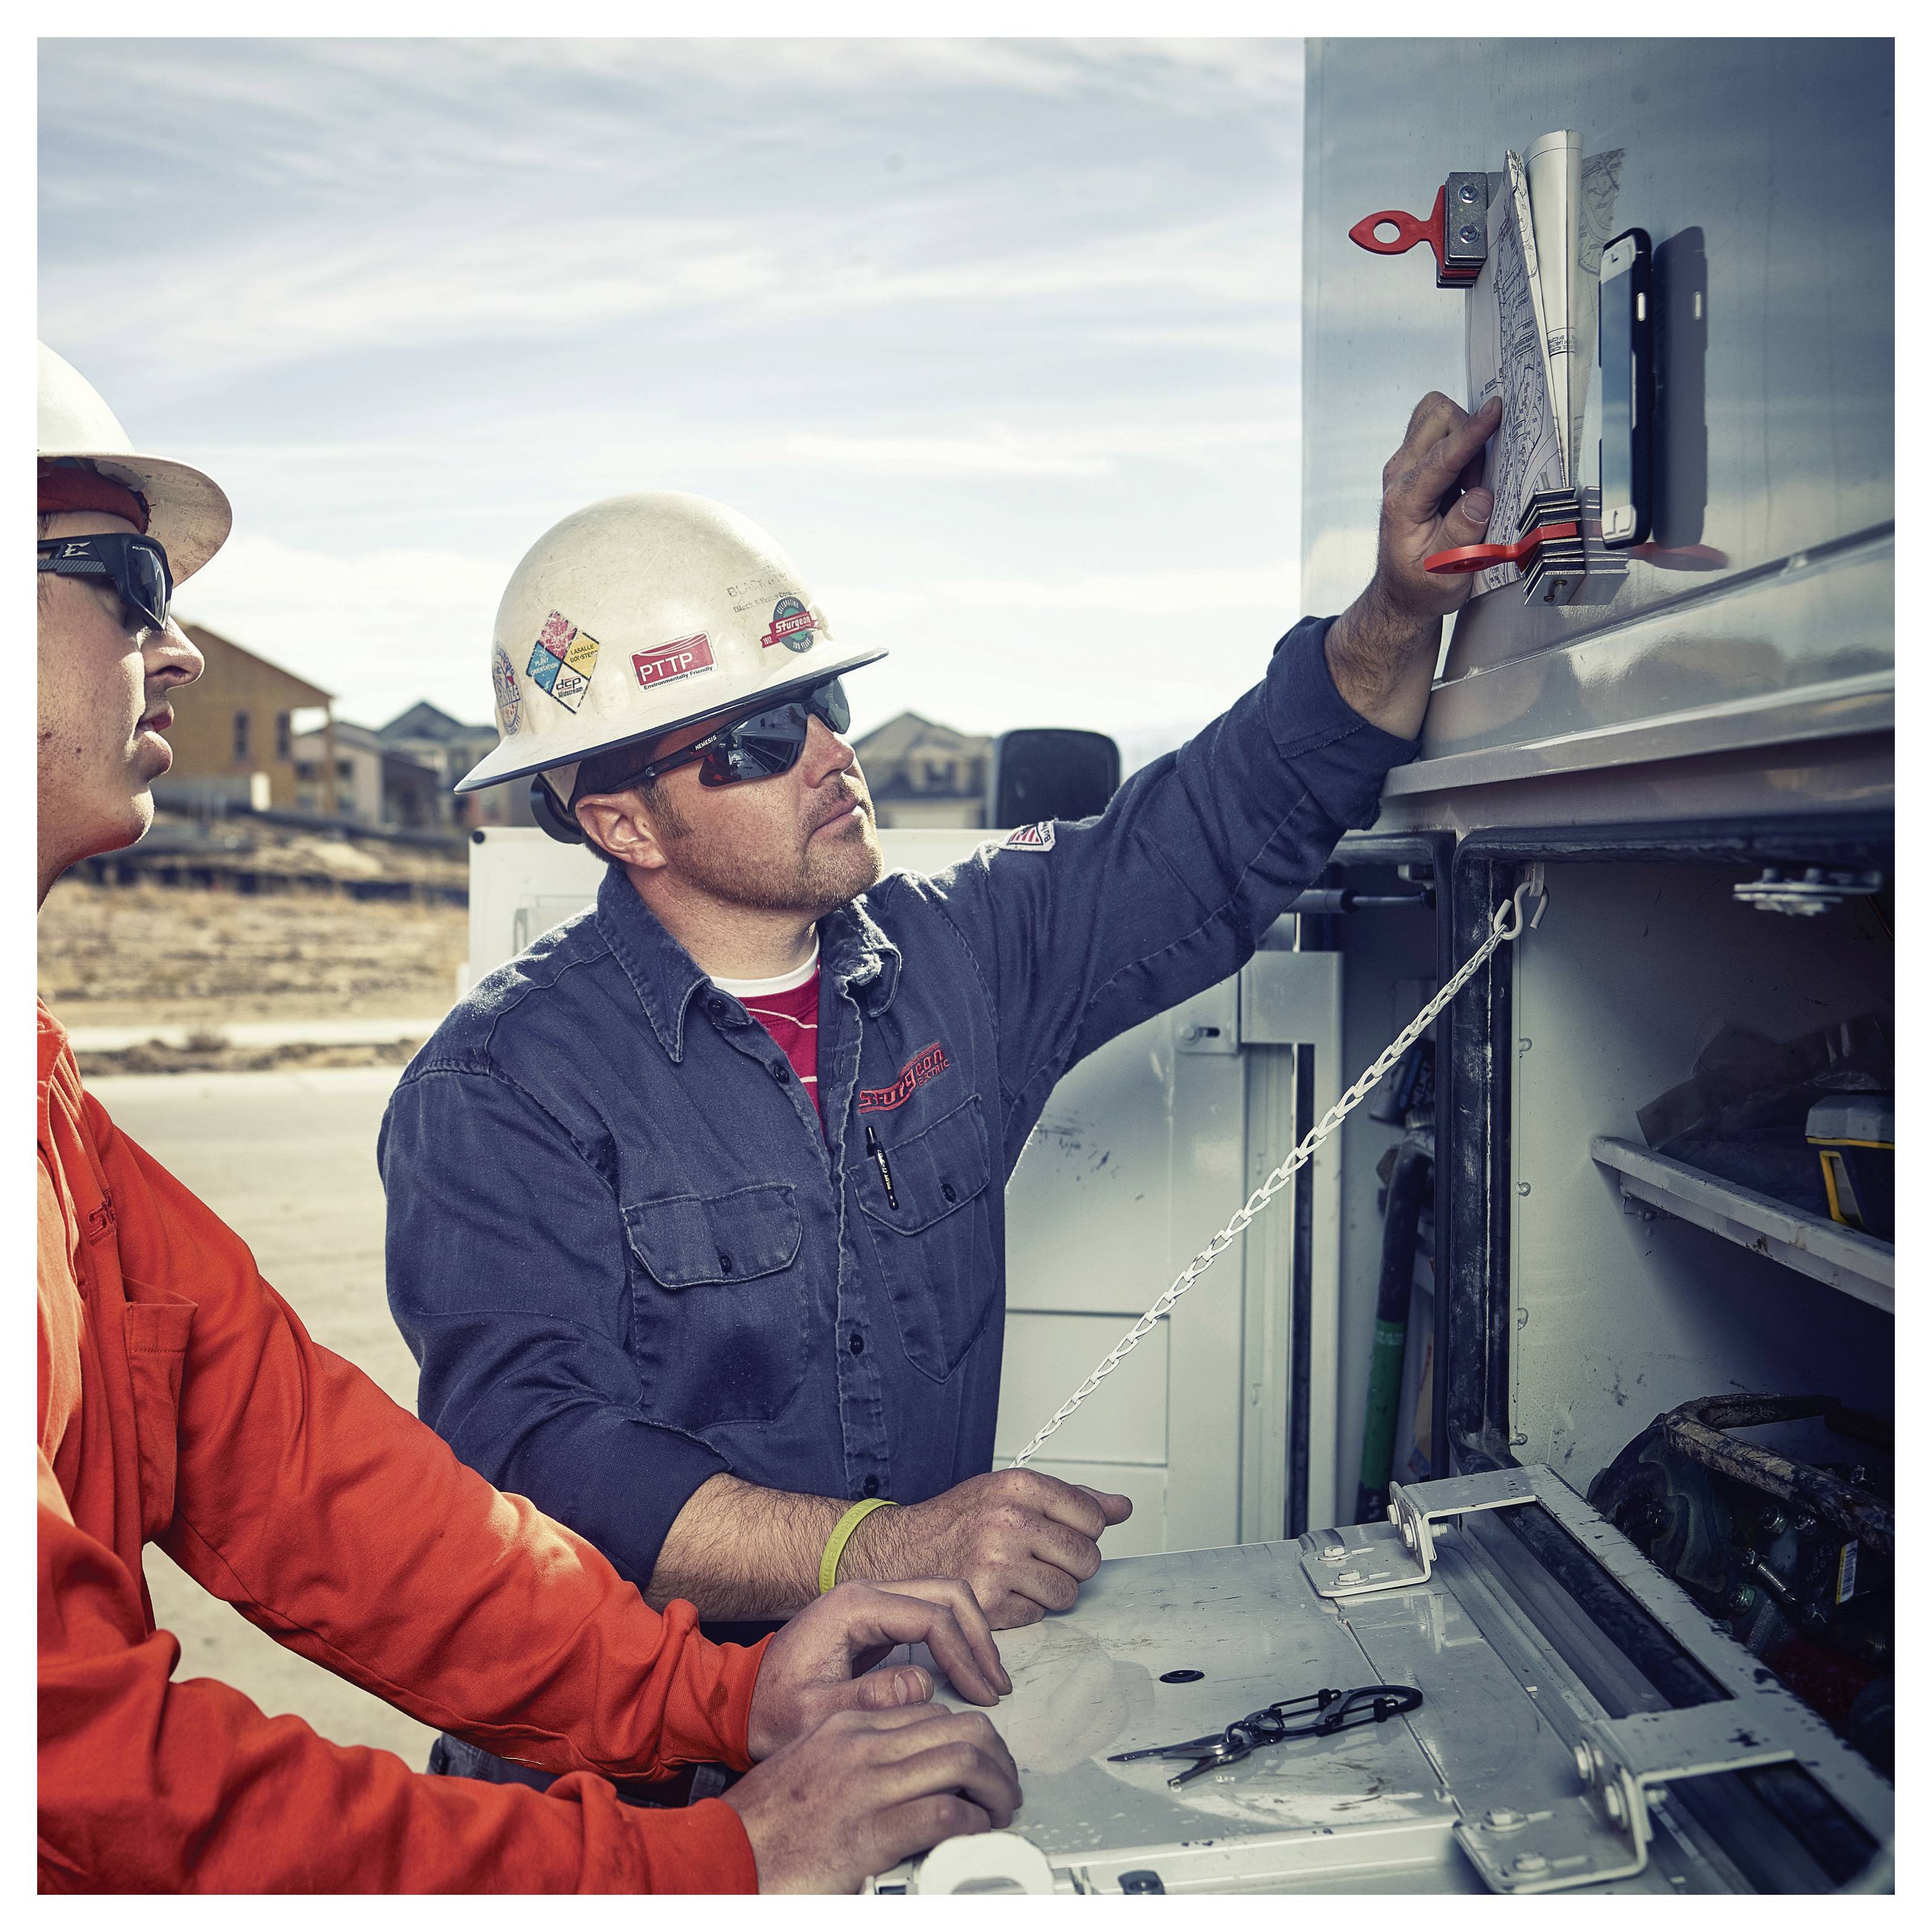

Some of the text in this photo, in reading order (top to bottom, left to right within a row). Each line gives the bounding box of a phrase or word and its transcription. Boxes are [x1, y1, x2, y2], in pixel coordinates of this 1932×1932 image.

[777, 599, 799, 614] CELEBRATING
[776, 616, 811, 633] Sturgeon
[763, 636, 773, 645] 1912
[793, 637, 811, 650] 100 YEARS
[570, 643, 595, 655] LASALLE
[639, 652, 693, 682] PTTP
[556, 678, 581, 689] dcp
[644, 666, 712, 690] Environmentally Friendly
[695, 735, 717, 750] NEMESIS
[859, 1049, 943, 1106] Sturgeon
[822, 1550, 837, 1592] Behin
